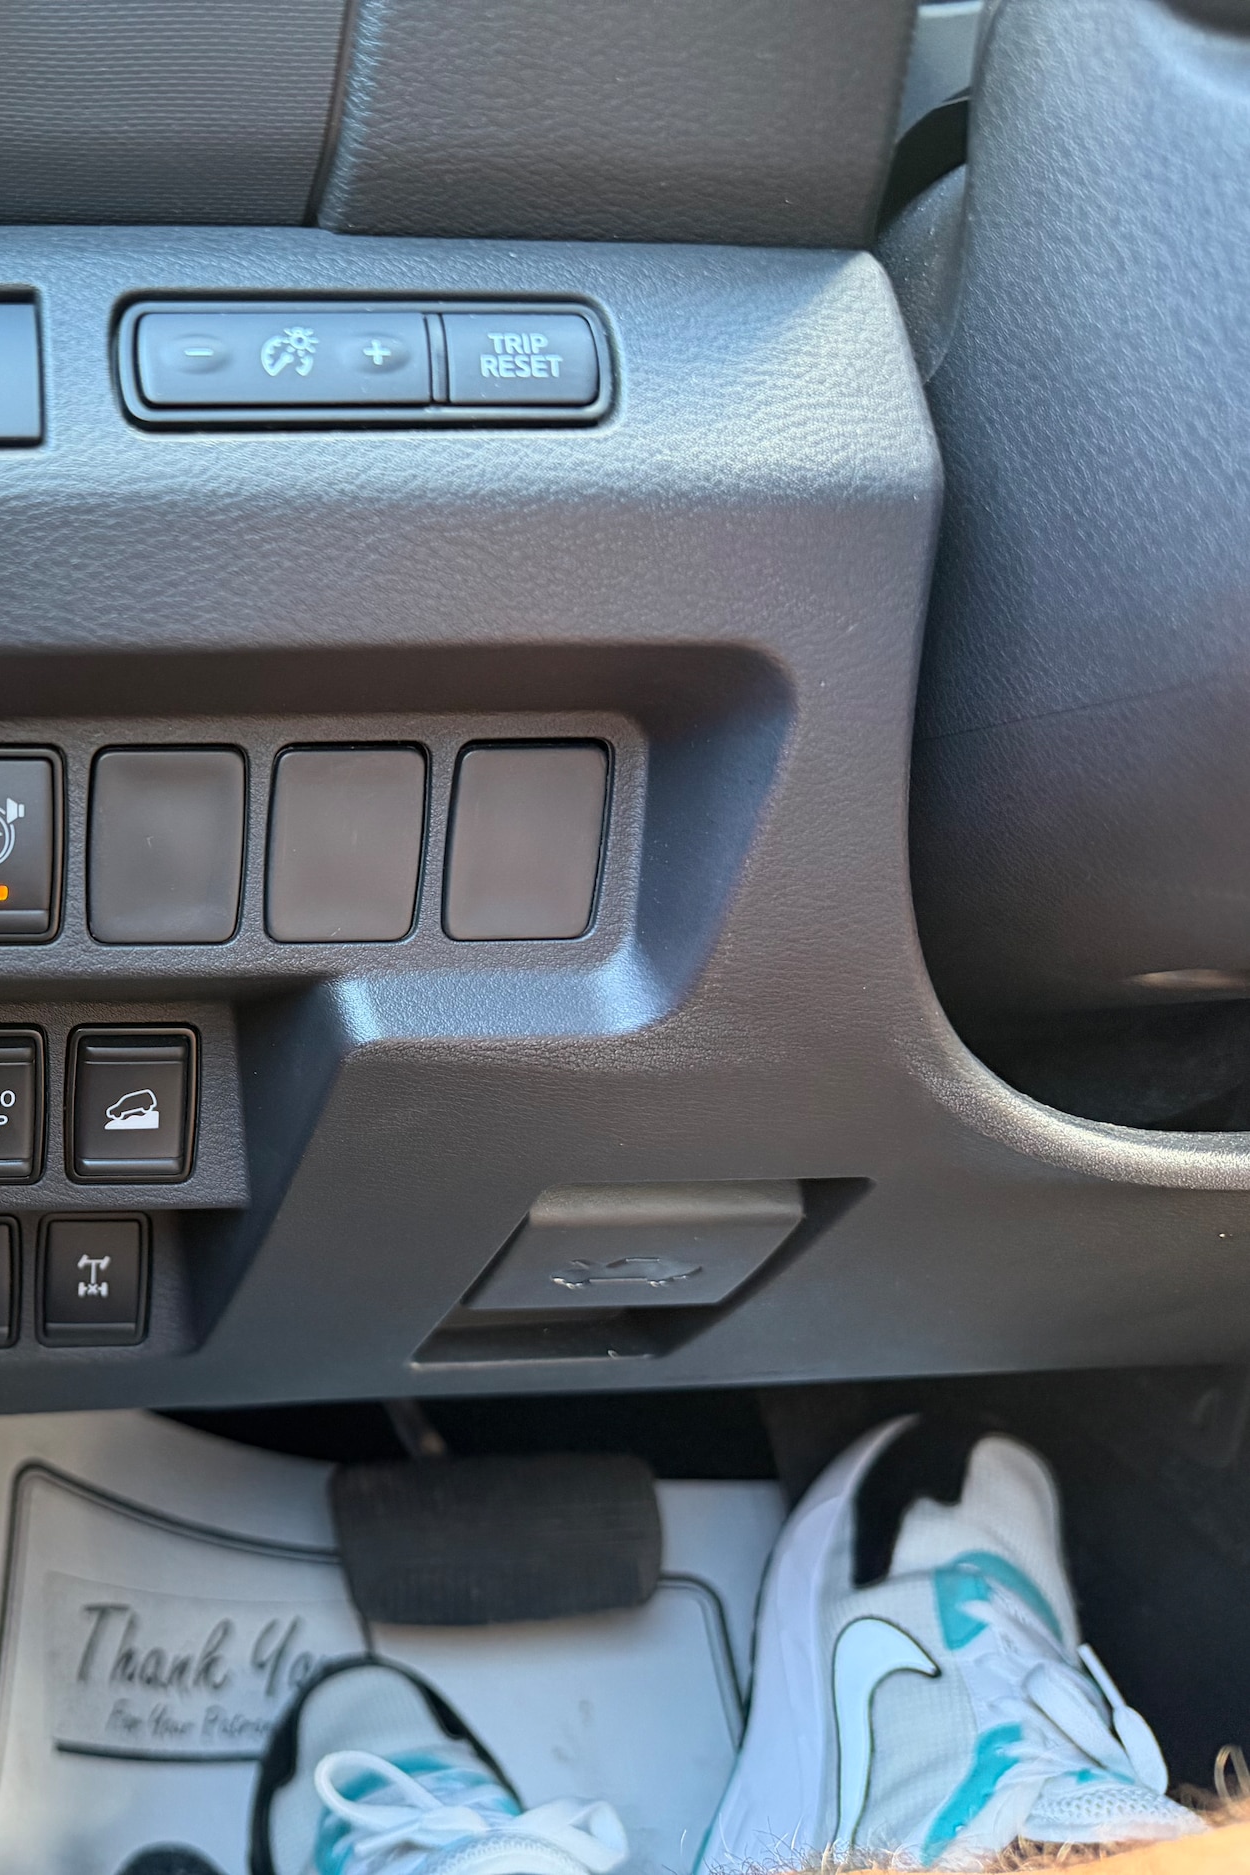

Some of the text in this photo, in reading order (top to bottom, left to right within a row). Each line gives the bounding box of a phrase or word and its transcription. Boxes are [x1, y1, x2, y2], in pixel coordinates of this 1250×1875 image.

[487, 333, 548, 355] TRIP
[479, 354, 563, 379] RESET
[77, 1603, 315, 1698] Thank Yo
